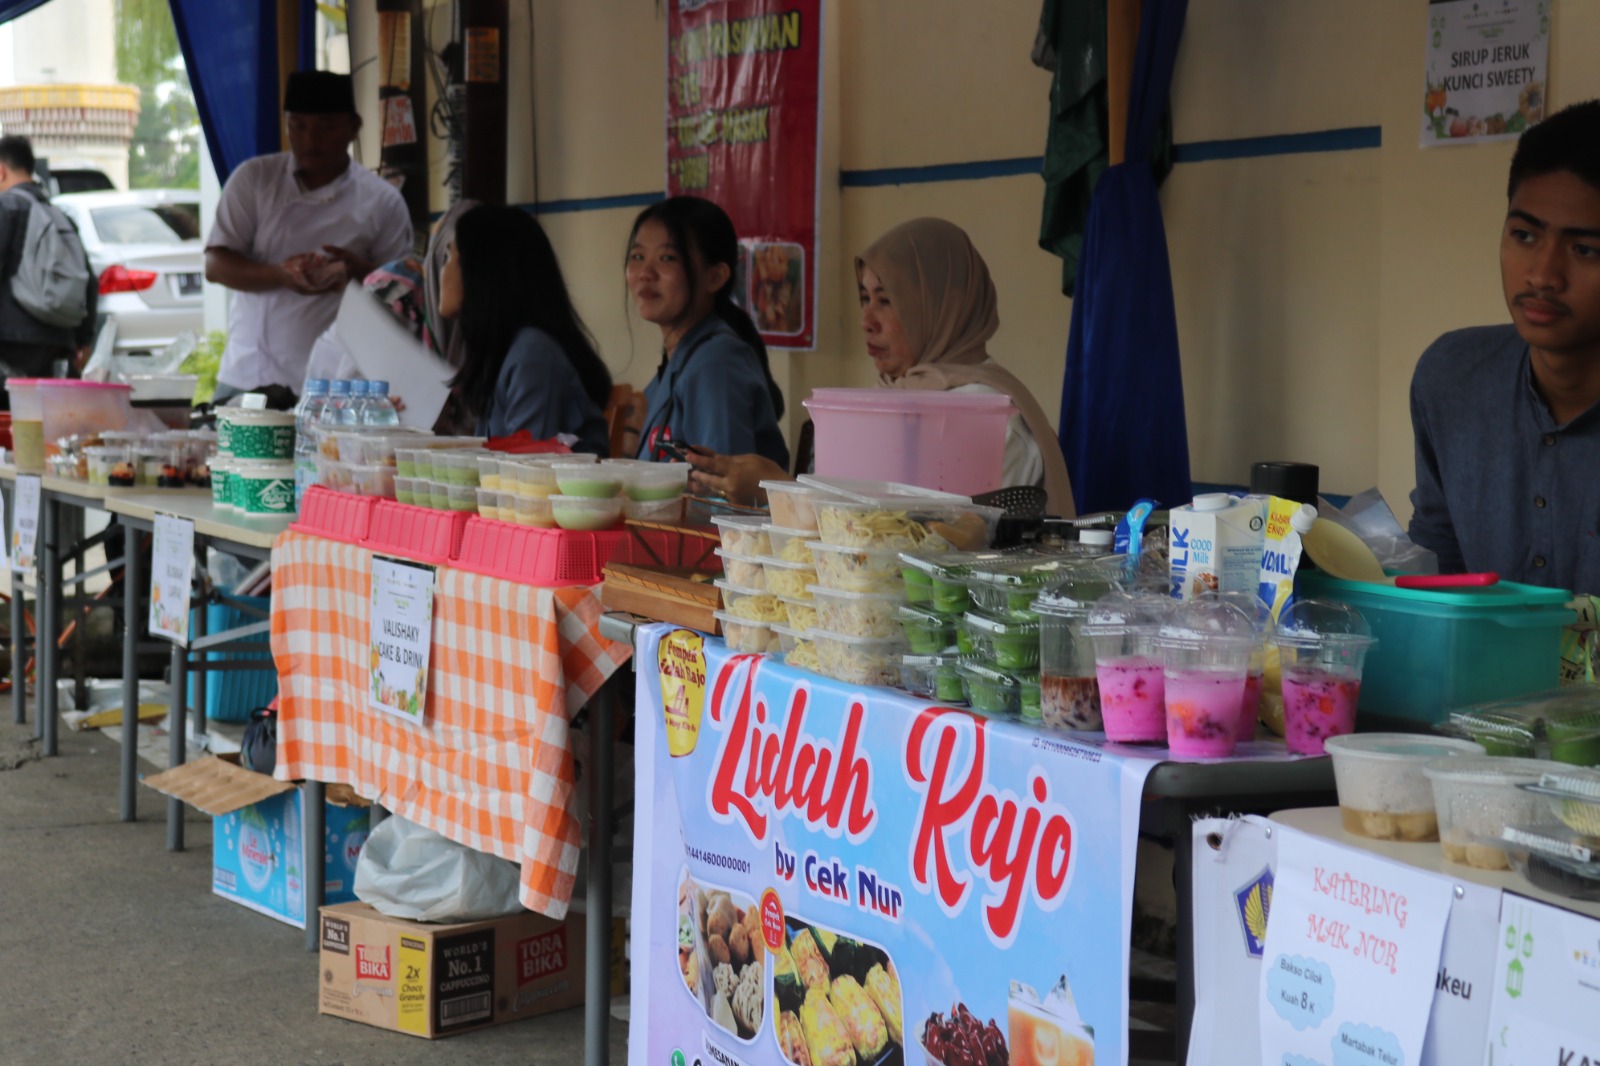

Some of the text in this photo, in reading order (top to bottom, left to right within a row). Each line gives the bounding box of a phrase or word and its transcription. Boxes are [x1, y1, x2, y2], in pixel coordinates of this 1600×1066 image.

[1450, 43, 1531, 69] SIRUP JERUK
[1443, 67, 1536, 92] KUNCI SWEETY
[1192, 551, 1209, 564] Milk
[383, 617, 420, 645] VALISHAKY
[378, 641, 424, 671] CAKE & DRINK
[711, 653, 1073, 939] Lidah Rajo
[775, 840, 902, 919] by Cek Nur
[1312, 867, 1409, 929] KATERING
[443, 941, 488, 958] WORLD'S
[520, 932, 564, 961] TORA
[1306, 913, 1399, 975] MAK NUR
[359, 960, 389, 978] BIKA
[405, 964, 420, 980] 2x
[523, 951, 563, 978] BIKA
[1280, 958, 1323, 985] Bakso Cilok
[401, 983, 423, 993] Choco
[439, 973, 490, 993] CAPPUCCINO
[1281, 989, 1315, 1014] Kuah 8 K
[1341, 1032, 1376, 1058] Martabak
